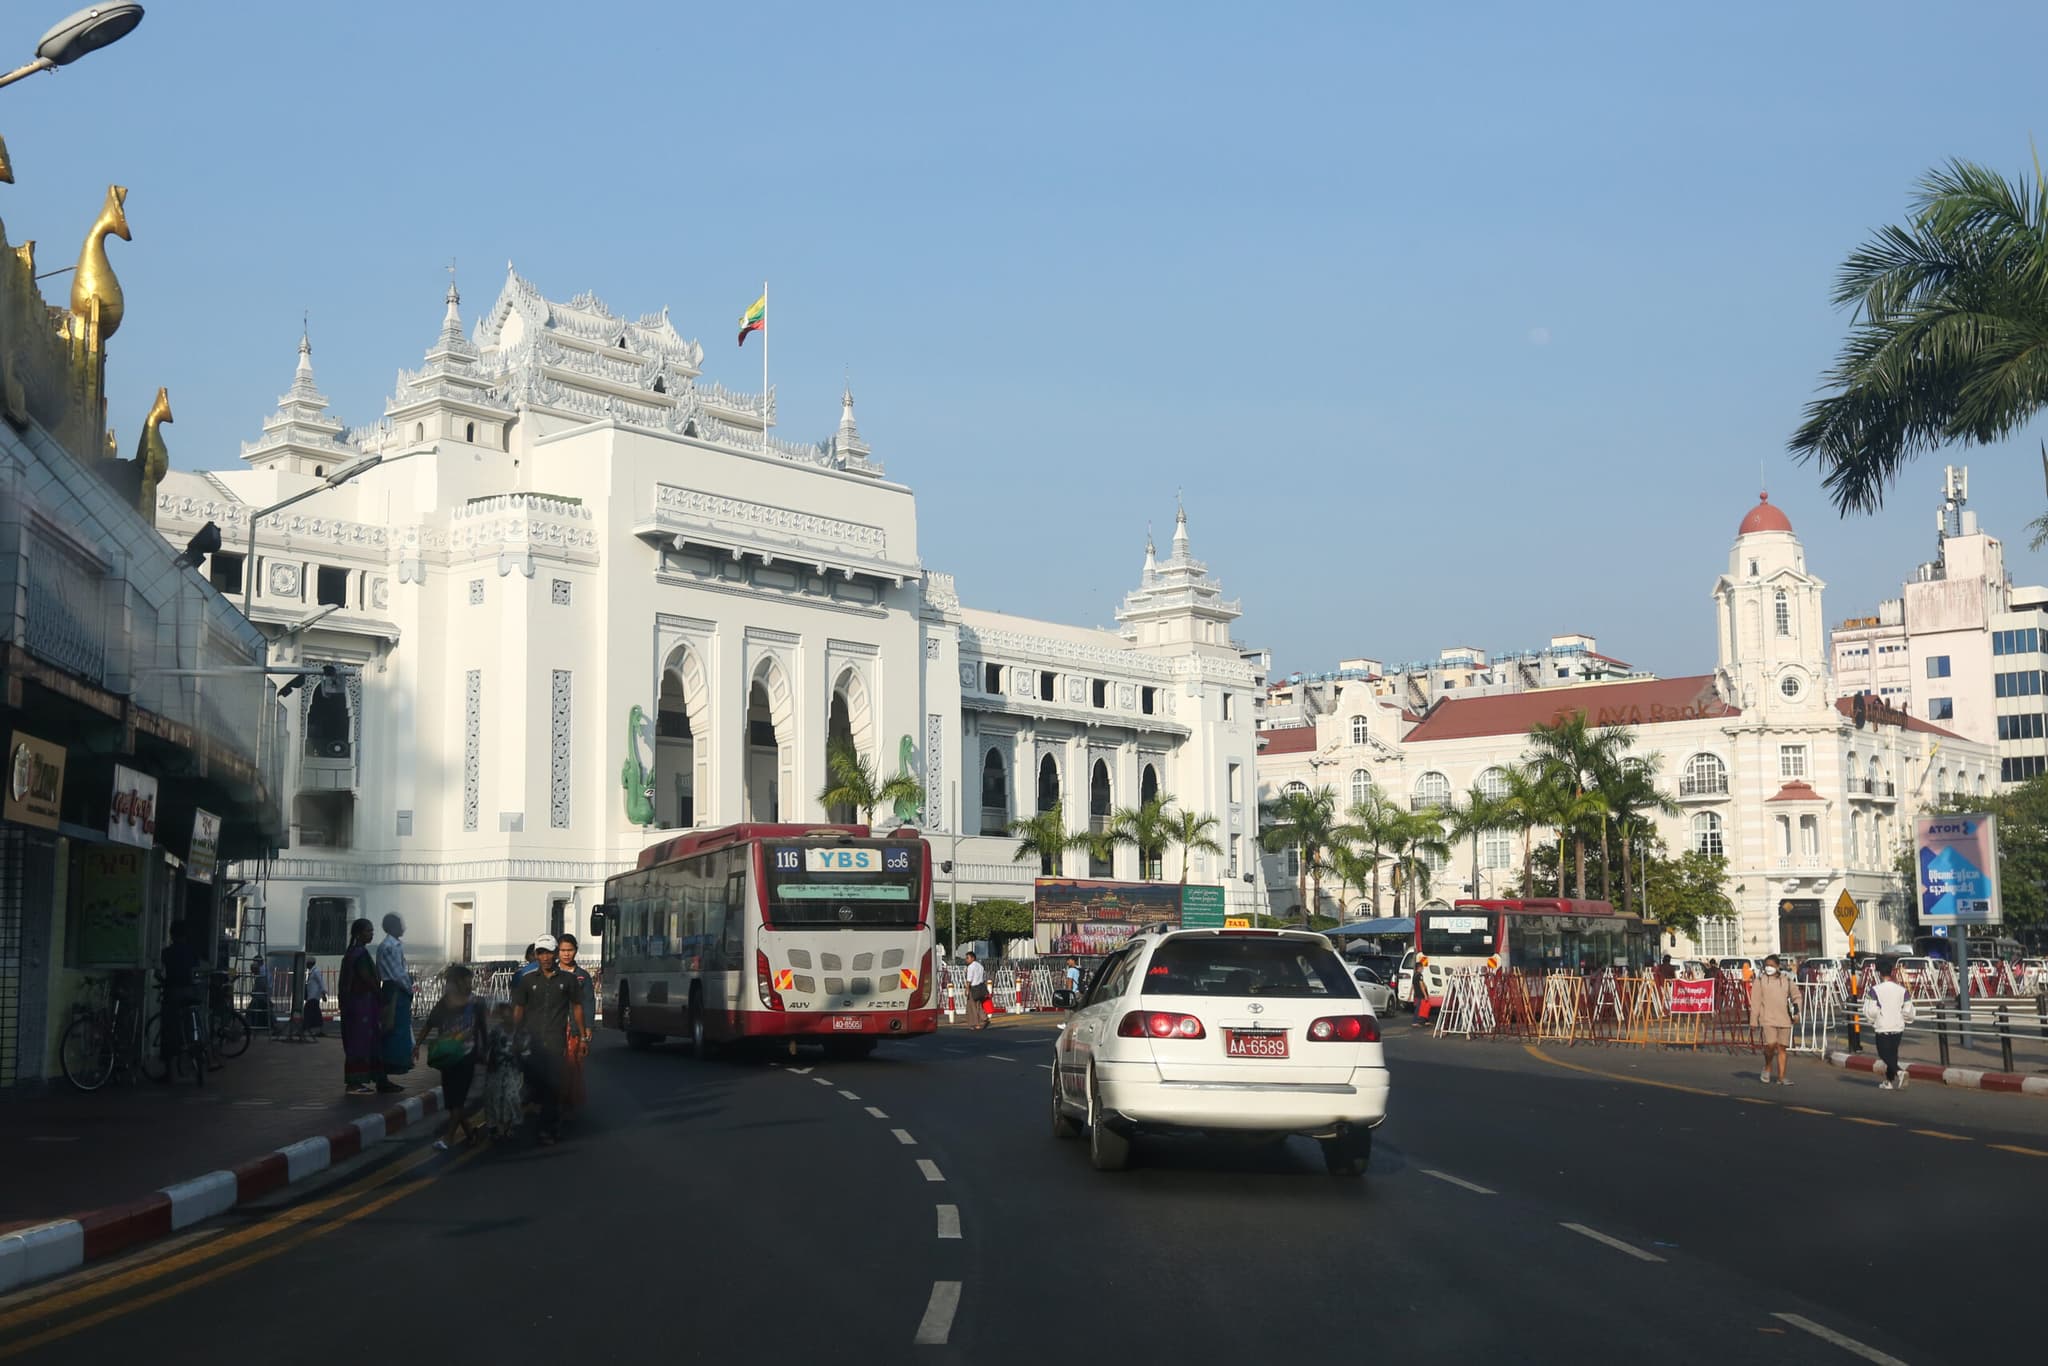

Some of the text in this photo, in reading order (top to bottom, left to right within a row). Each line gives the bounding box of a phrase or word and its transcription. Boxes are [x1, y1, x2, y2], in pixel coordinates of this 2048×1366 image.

[1598, 700, 1711, 726] AYA Bank
[1928, 823, 1960, 834] ATOM
[776, 852, 870, 868] 116 YBS
[1835, 906, 1855, 917] SLOW
[1230, 1039, 1285, 1055] AA-6589
